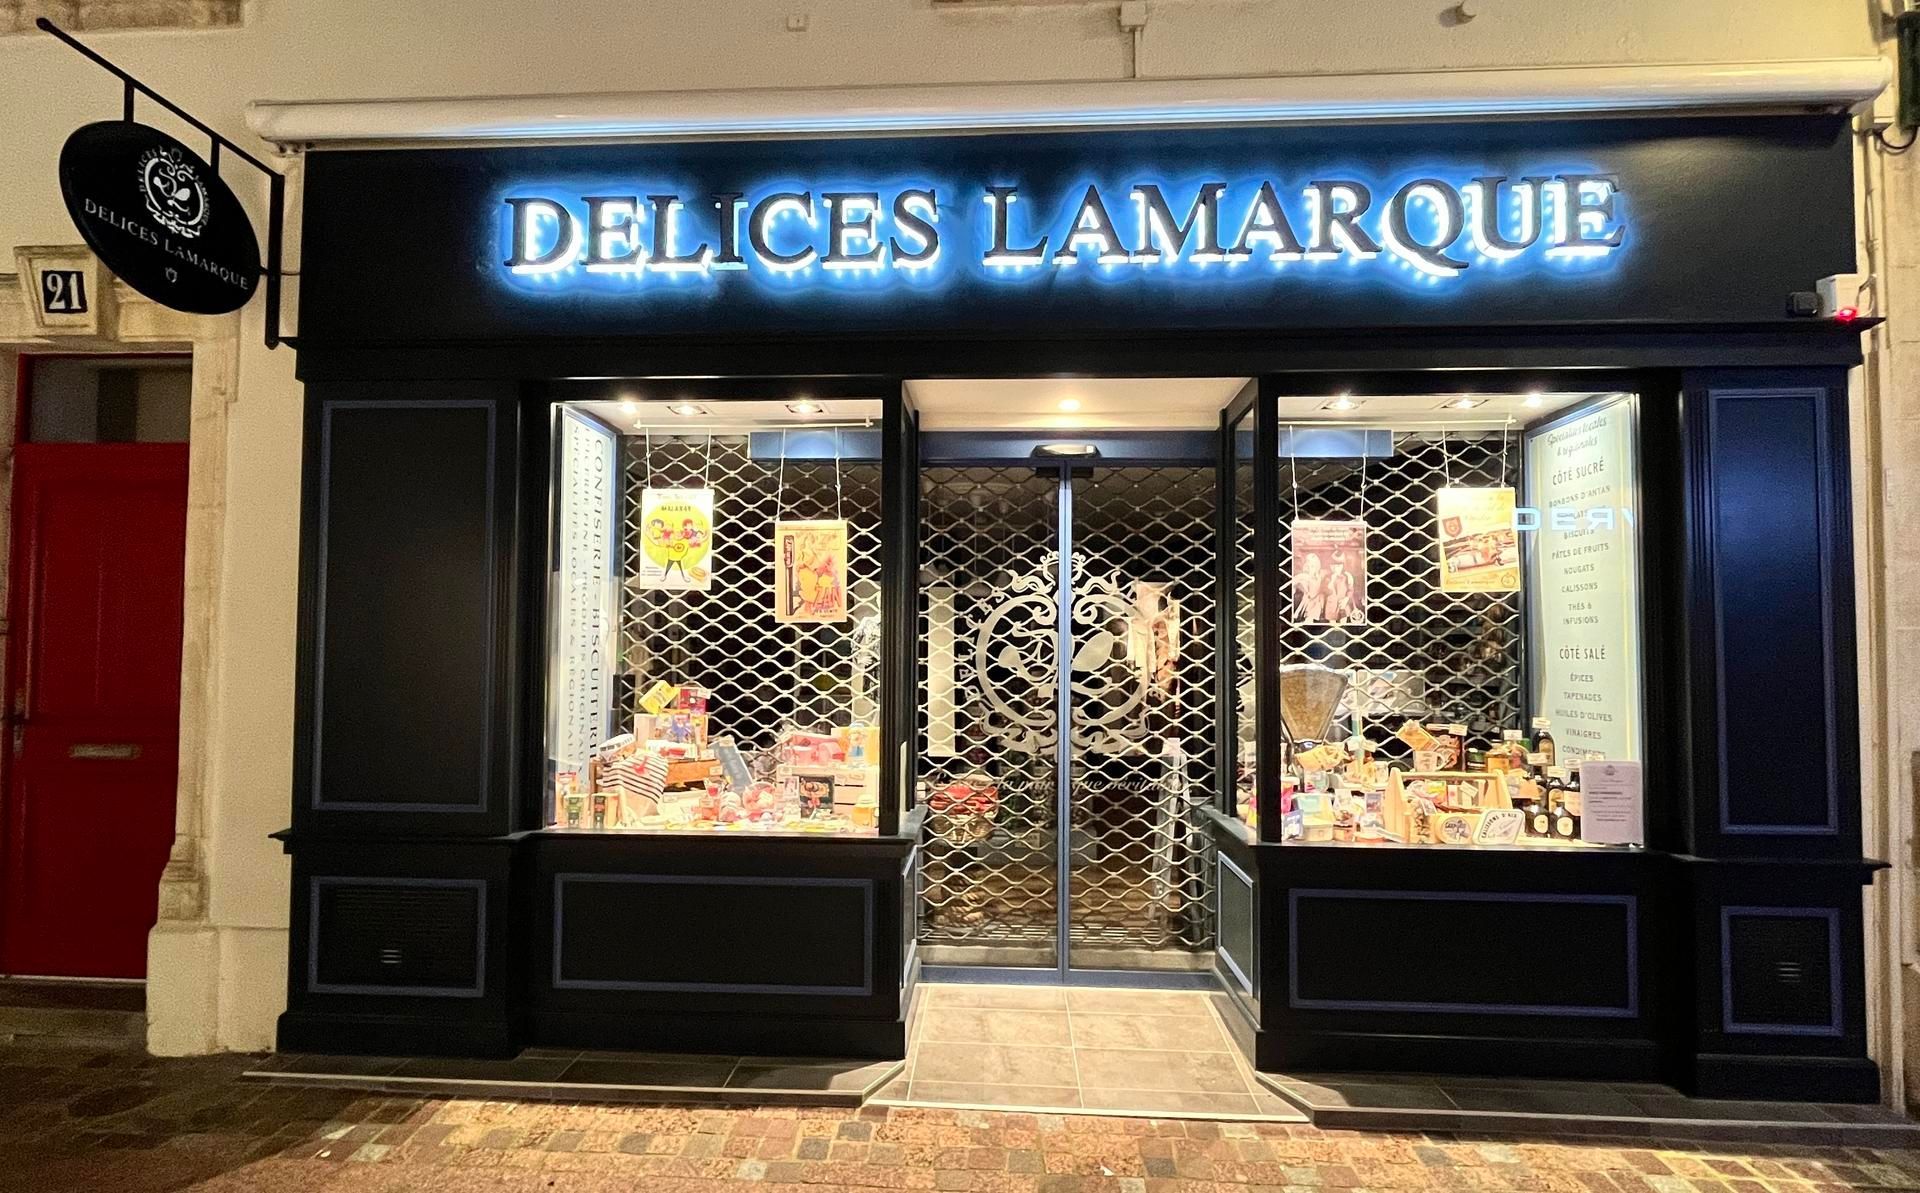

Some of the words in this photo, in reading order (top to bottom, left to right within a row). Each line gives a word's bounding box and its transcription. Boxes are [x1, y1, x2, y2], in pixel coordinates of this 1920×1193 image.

[503, 188, 941, 272] DELICES
[983, 173, 1626, 276] LAMARQUE
[85, 198, 158, 246] DELICES
[164, 238, 249, 290] LAMARQUE
[46, 273, 82, 310] 21
[1576, 456, 1604, 479] SUCRÉ
[1548, 494, 1579, 508] BONBONS
[592, 439, 604, 586] CONFISERIE
[1572, 547, 1582, 556] DE
[1584, 542, 1609, 554] FRUITS
[1564, 563, 1594, 575] NOUGATS
[1562, 582, 1598, 592] CALISSONS
[812, 585, 842, 609] ZAN
[1563, 616, 1599, 625] INFUSIONS
[1560, 644, 1580, 660] CÔTÉ
[1584, 644, 1606, 660] SALÉ
[1570, 672, 1594, 682] ÉPICES
[1564, 692, 1602, 702] TAPENADES
[1580, 712, 1613, 722] D'OLIVES
[1566, 728, 1602, 740] VINAIGRES
